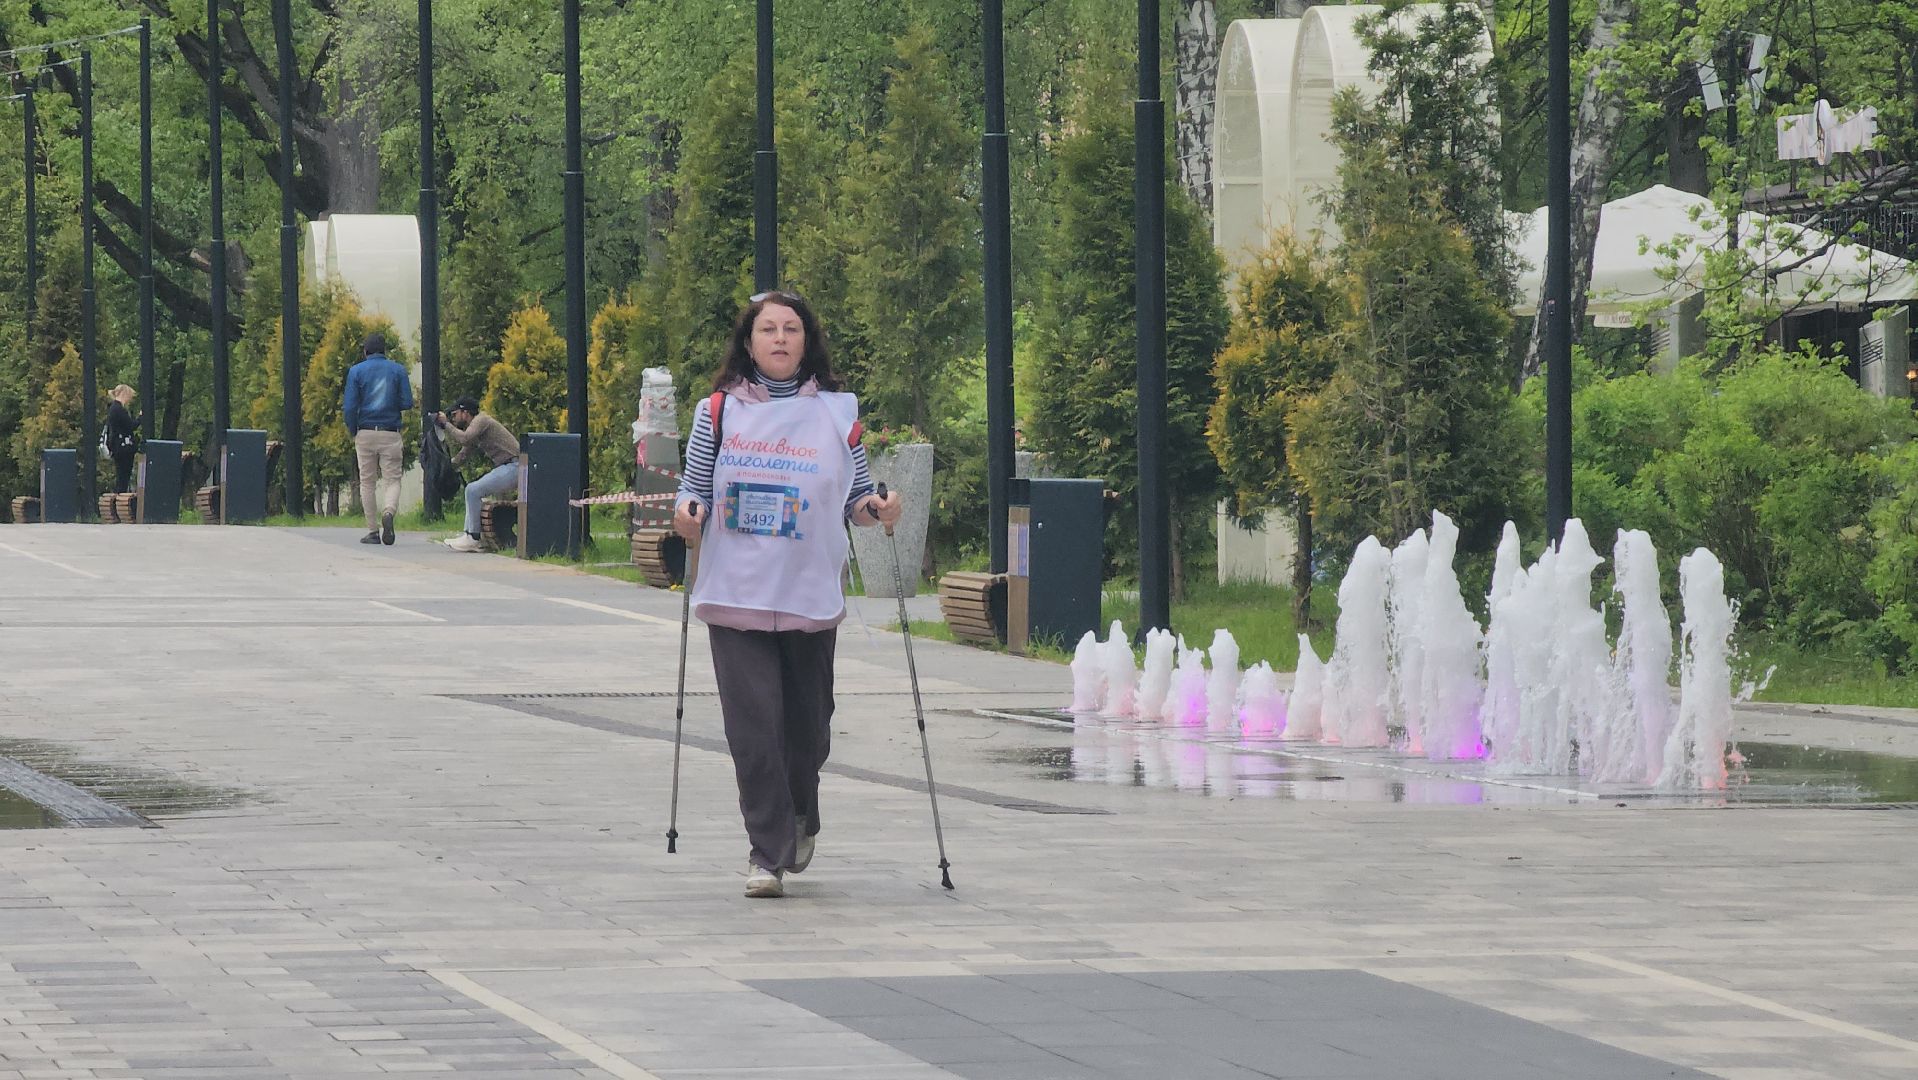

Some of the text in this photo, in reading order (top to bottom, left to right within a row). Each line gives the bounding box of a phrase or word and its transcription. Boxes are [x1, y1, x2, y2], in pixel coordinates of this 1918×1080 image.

[723, 432, 818, 457] Активное
[720, 447, 819, 473] долголетие
[743, 512, 775, 527] 3492
